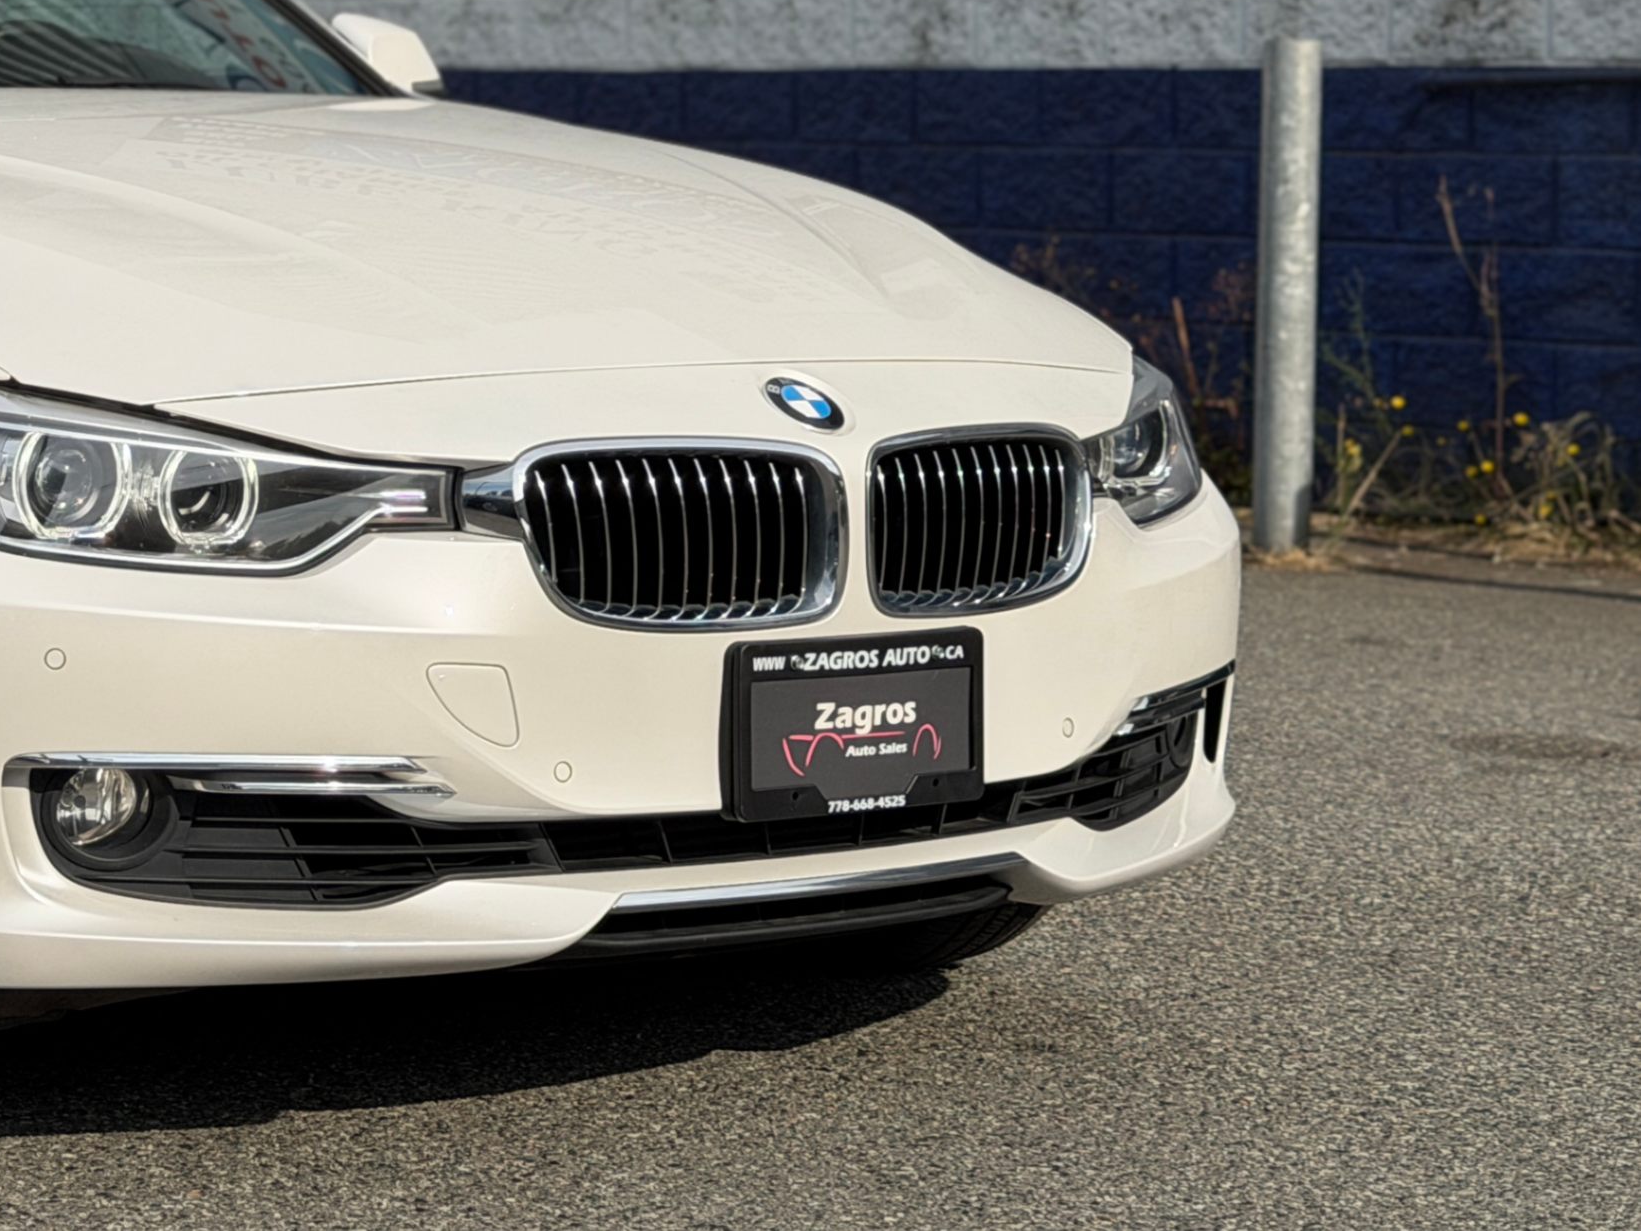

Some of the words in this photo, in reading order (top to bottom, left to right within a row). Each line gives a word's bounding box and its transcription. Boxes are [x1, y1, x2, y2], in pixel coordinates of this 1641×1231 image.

[753, 656, 786, 671] WWW
[882, 645, 931, 666] AUTO
[814, 701, 916, 735] Zagros
[845, 745, 876, 757] Auto
[879, 742, 907, 755] Sales
[828, 795, 906, 813] 778-668-4525
